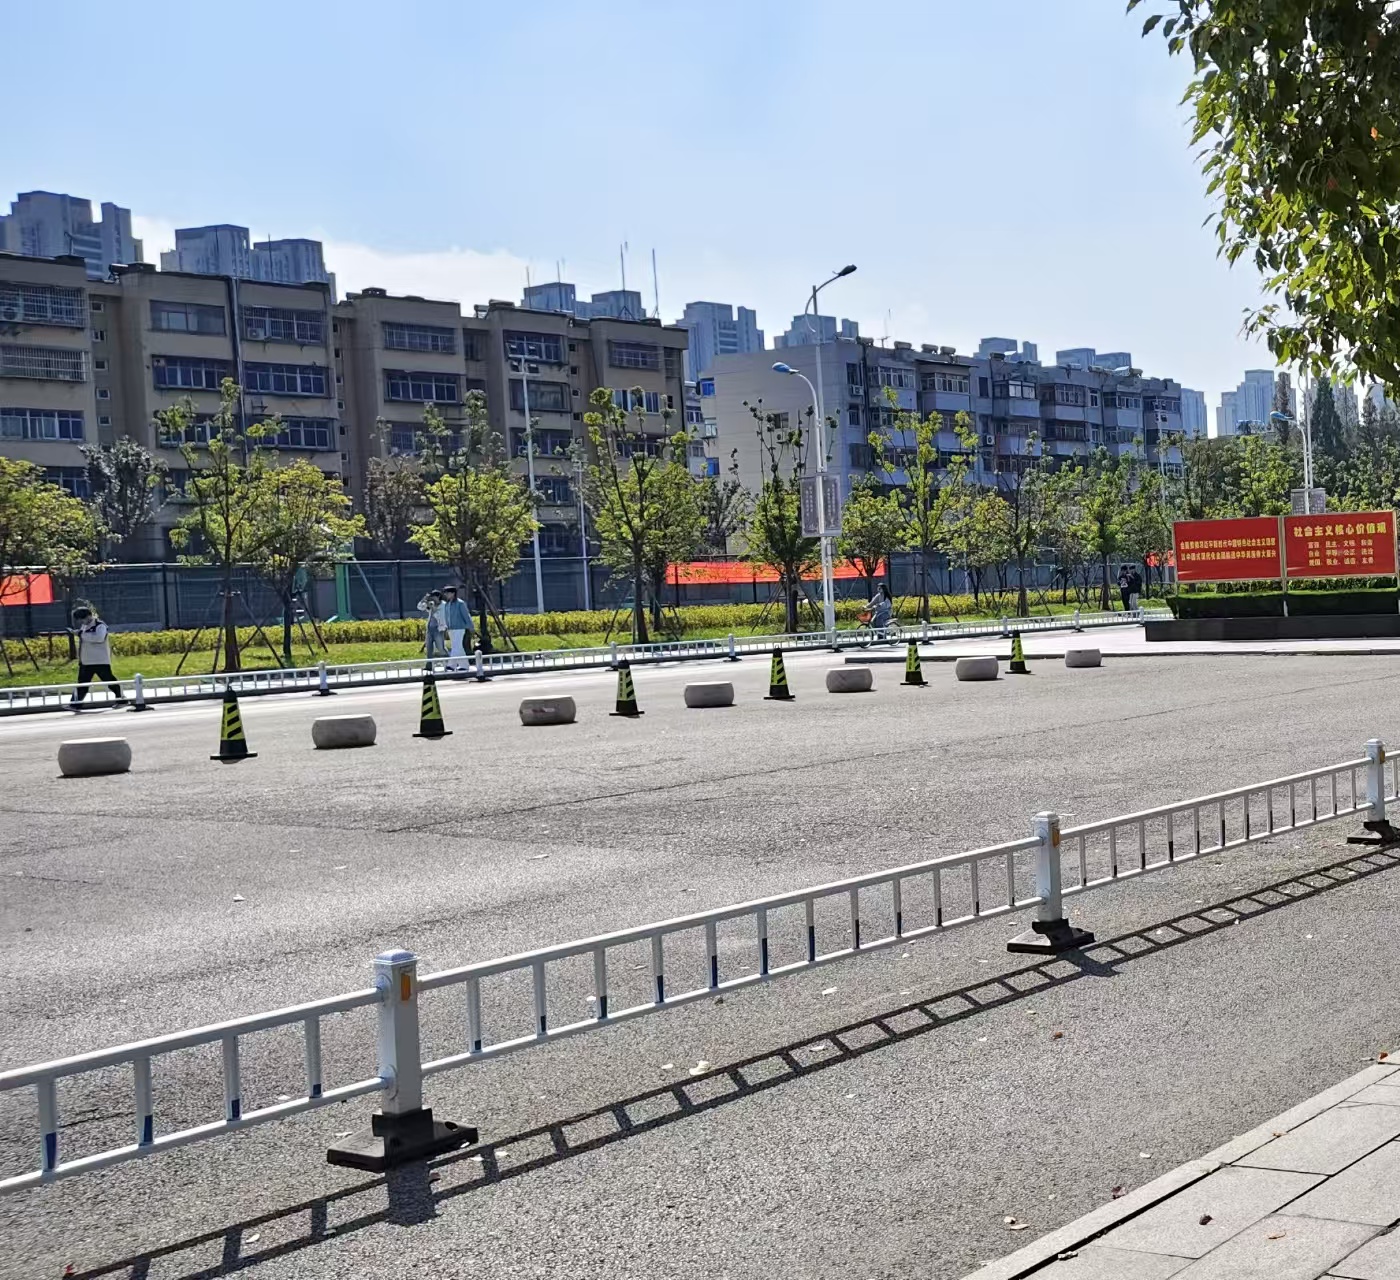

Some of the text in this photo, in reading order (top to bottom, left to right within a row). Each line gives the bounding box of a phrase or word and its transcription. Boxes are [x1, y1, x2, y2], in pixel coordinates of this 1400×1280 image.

[1293, 521, 1387, 538] 社会主义核心价值观
